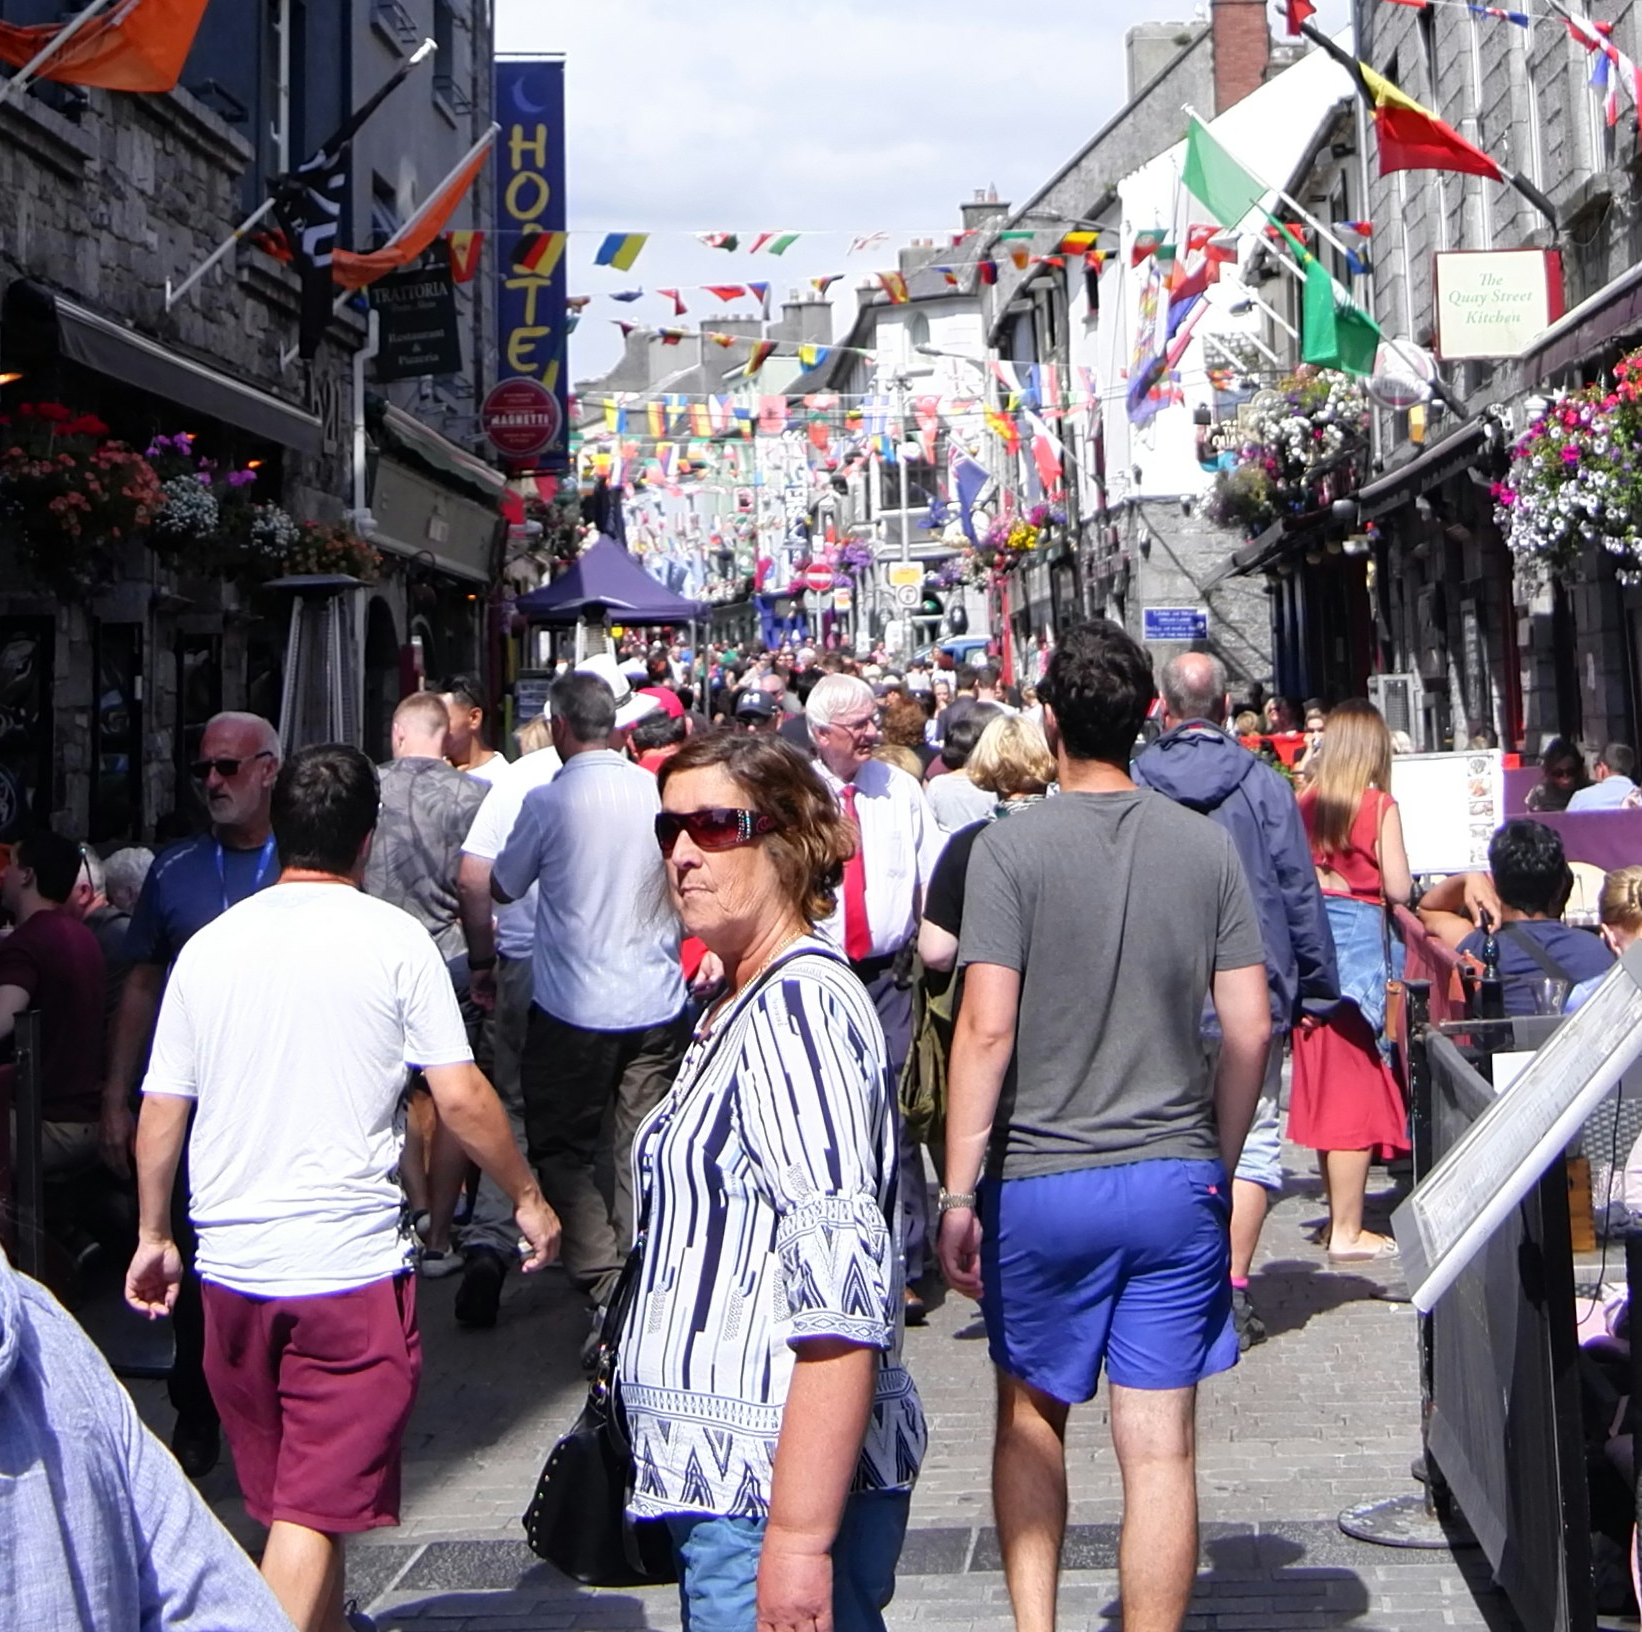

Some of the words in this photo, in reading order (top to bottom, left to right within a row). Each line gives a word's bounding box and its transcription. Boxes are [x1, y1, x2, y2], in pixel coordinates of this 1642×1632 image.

[1479, 273, 1503, 286] The
[372, 281, 449, 303] TRATTORIA
[1449, 290, 1487, 307] Quay
[1491, 289, 1532, 302] Street
[1465, 311, 1521, 324] Kitchen
